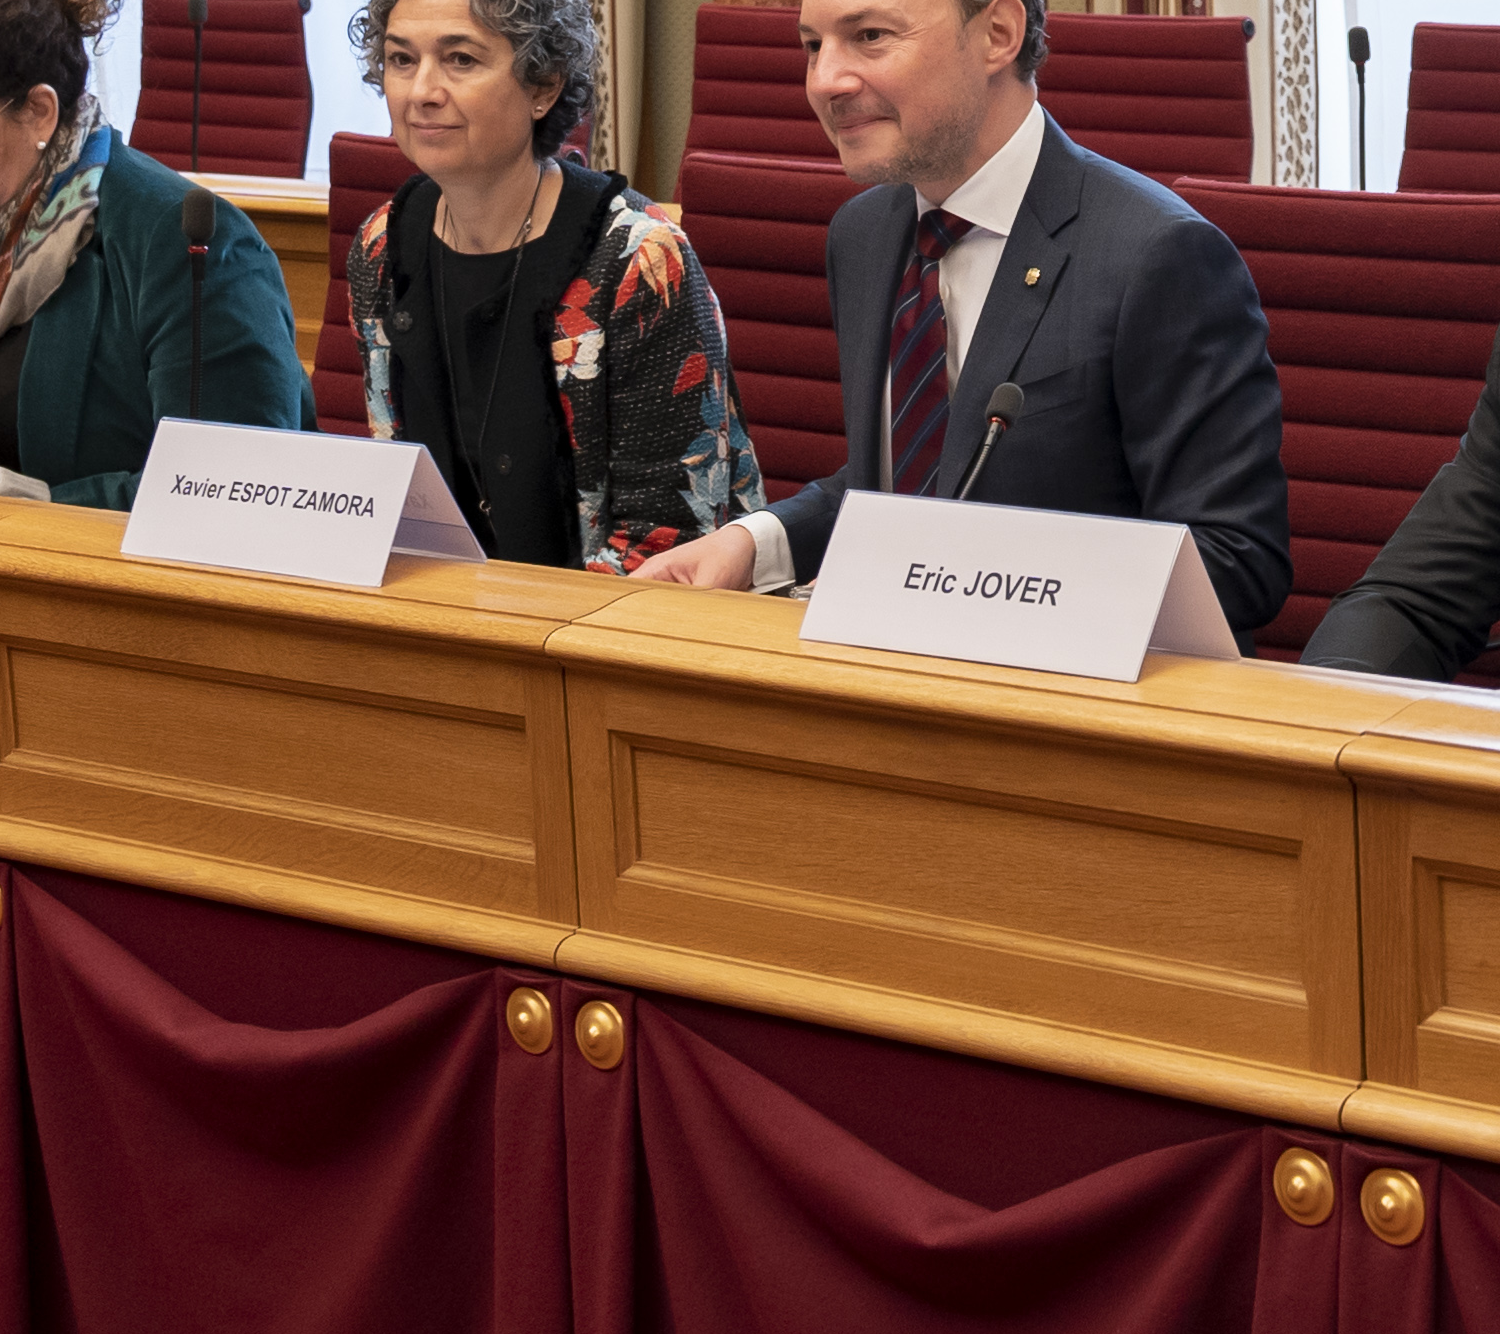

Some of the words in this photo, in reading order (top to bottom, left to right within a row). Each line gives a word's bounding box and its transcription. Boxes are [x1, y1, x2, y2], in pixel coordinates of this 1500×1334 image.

[170, 474, 226, 499] Xavier
[228, 481, 293, 507] ESPOT
[292, 489, 374, 518] ZAMORA
[903, 563, 957, 594] Eric
[963, 571, 1062, 606] JOVER
